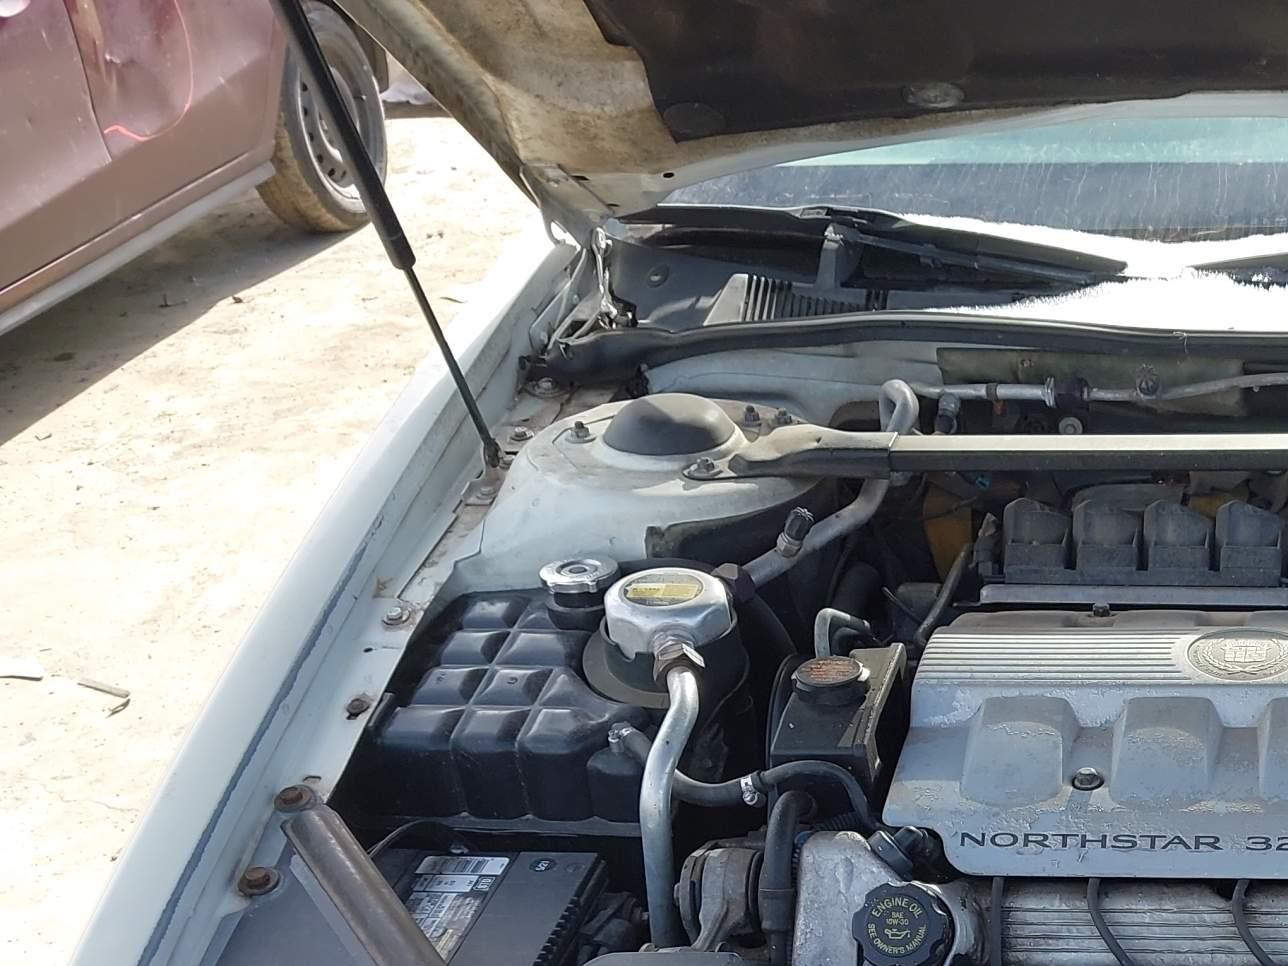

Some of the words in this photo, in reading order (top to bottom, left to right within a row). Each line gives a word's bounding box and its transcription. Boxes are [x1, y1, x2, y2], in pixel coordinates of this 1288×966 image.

[960, 831, 1223, 852] NORTHSTAR
[871, 897, 910, 918] ENGINE
[909, 903, 923, 919] OIL
[886, 918, 909, 926] 10W-30
[867, 923, 878, 940] SEE
[873, 937, 906, 954] OWNER'S
[905, 924, 927, 951] MANUAL
